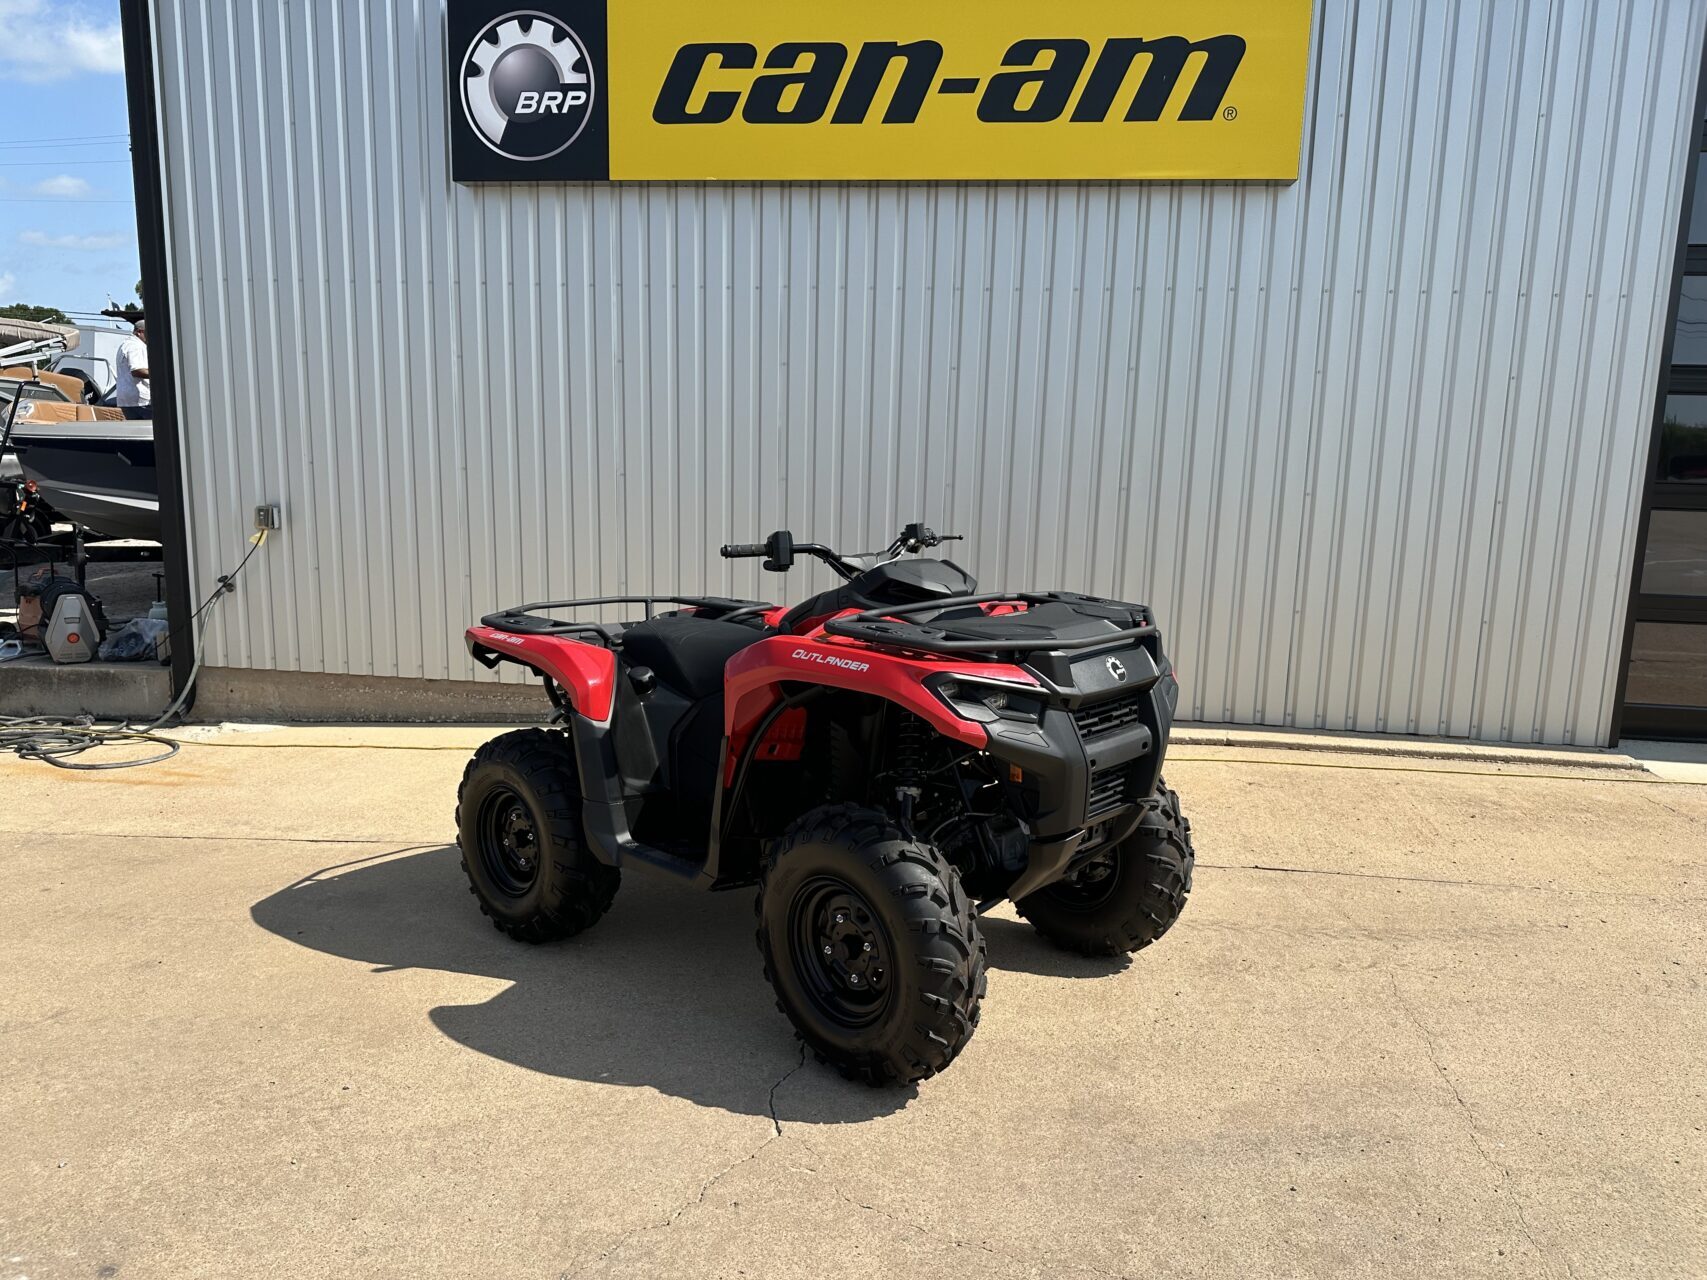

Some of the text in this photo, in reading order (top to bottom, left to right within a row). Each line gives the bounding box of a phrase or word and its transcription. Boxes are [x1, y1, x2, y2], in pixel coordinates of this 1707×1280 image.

[652, 35, 1246, 124] can-am
[515, 91, 587, 113] BRP
[792, 649, 869, 672] OUTLANDER
